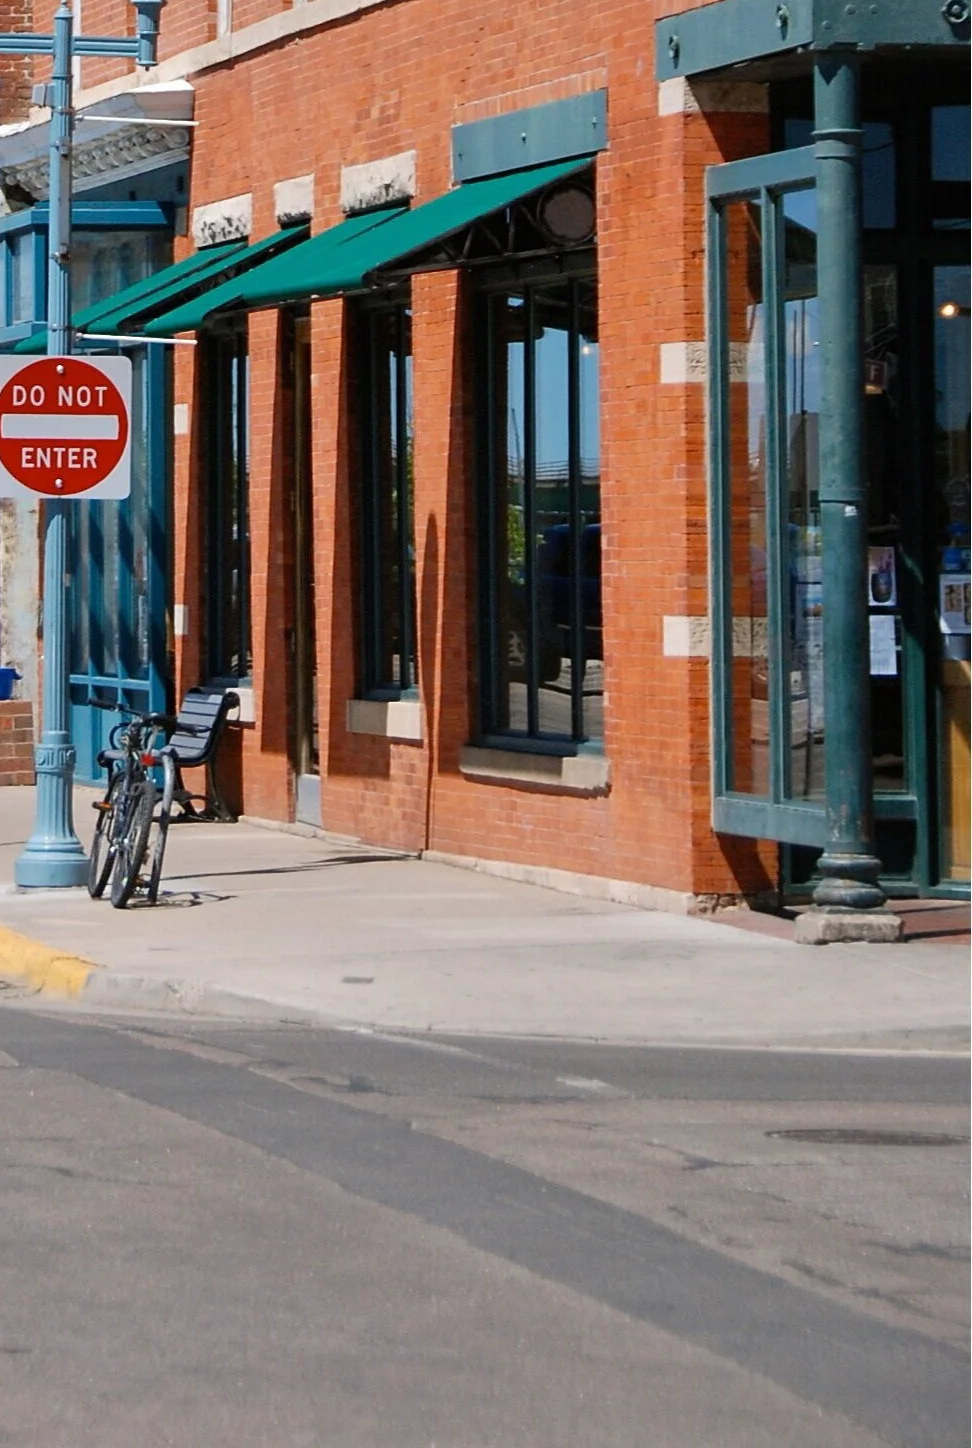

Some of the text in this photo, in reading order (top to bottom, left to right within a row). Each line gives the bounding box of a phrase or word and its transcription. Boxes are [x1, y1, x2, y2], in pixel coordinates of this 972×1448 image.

[12, 385, 108, 407] DO NOT
[21, 447, 97, 469] ENTER
